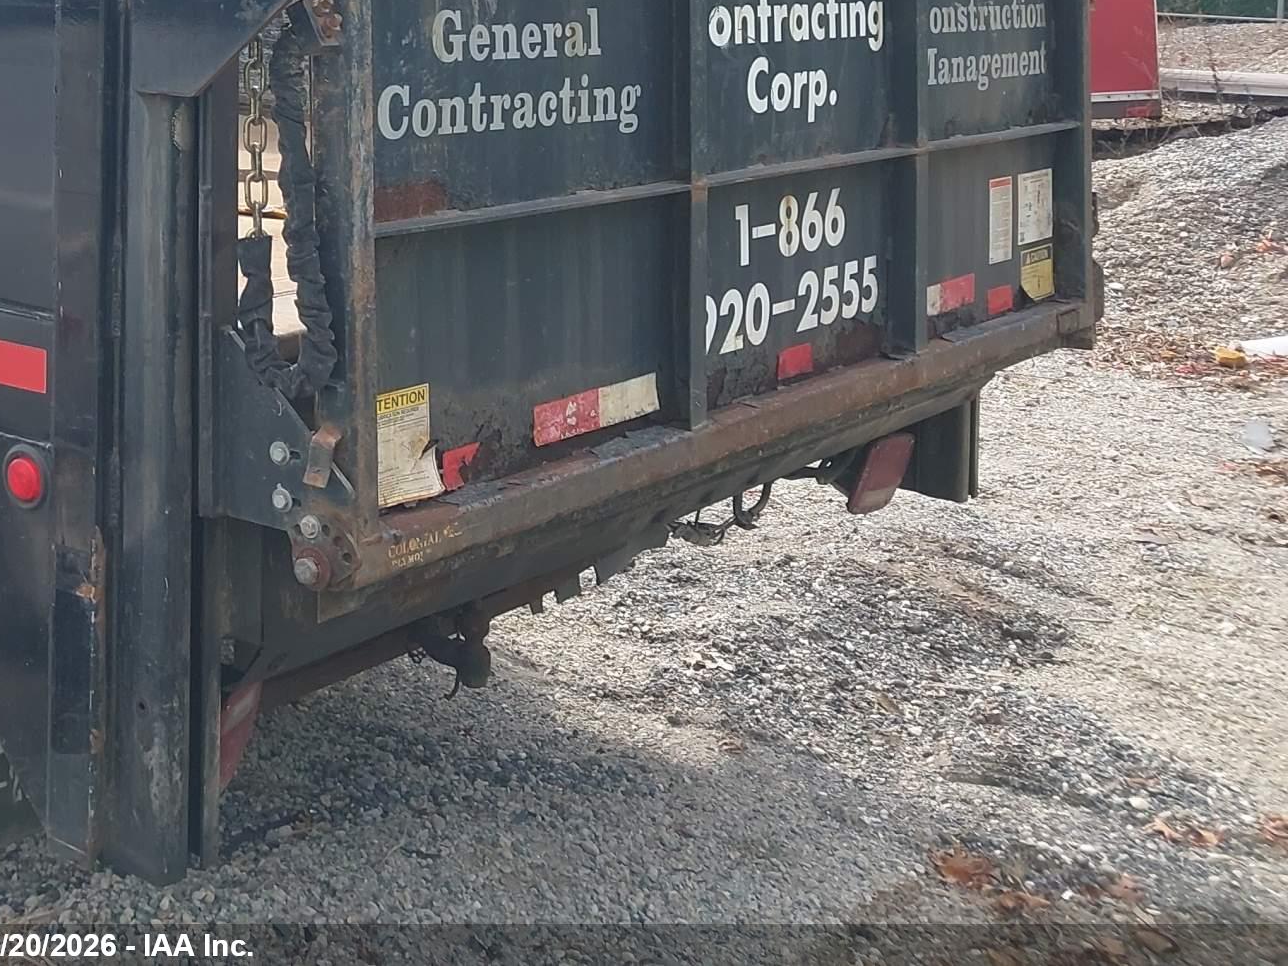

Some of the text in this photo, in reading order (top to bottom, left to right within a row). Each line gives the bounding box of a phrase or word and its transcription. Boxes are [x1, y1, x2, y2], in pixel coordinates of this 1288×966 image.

[432, 8, 602, 63] General
[377, 74, 642, 140] Contracting
[747, 56, 838, 123] Corp.
[735, 187, 846, 267] 1-866
[377, 388, 426, 412] TENTION
